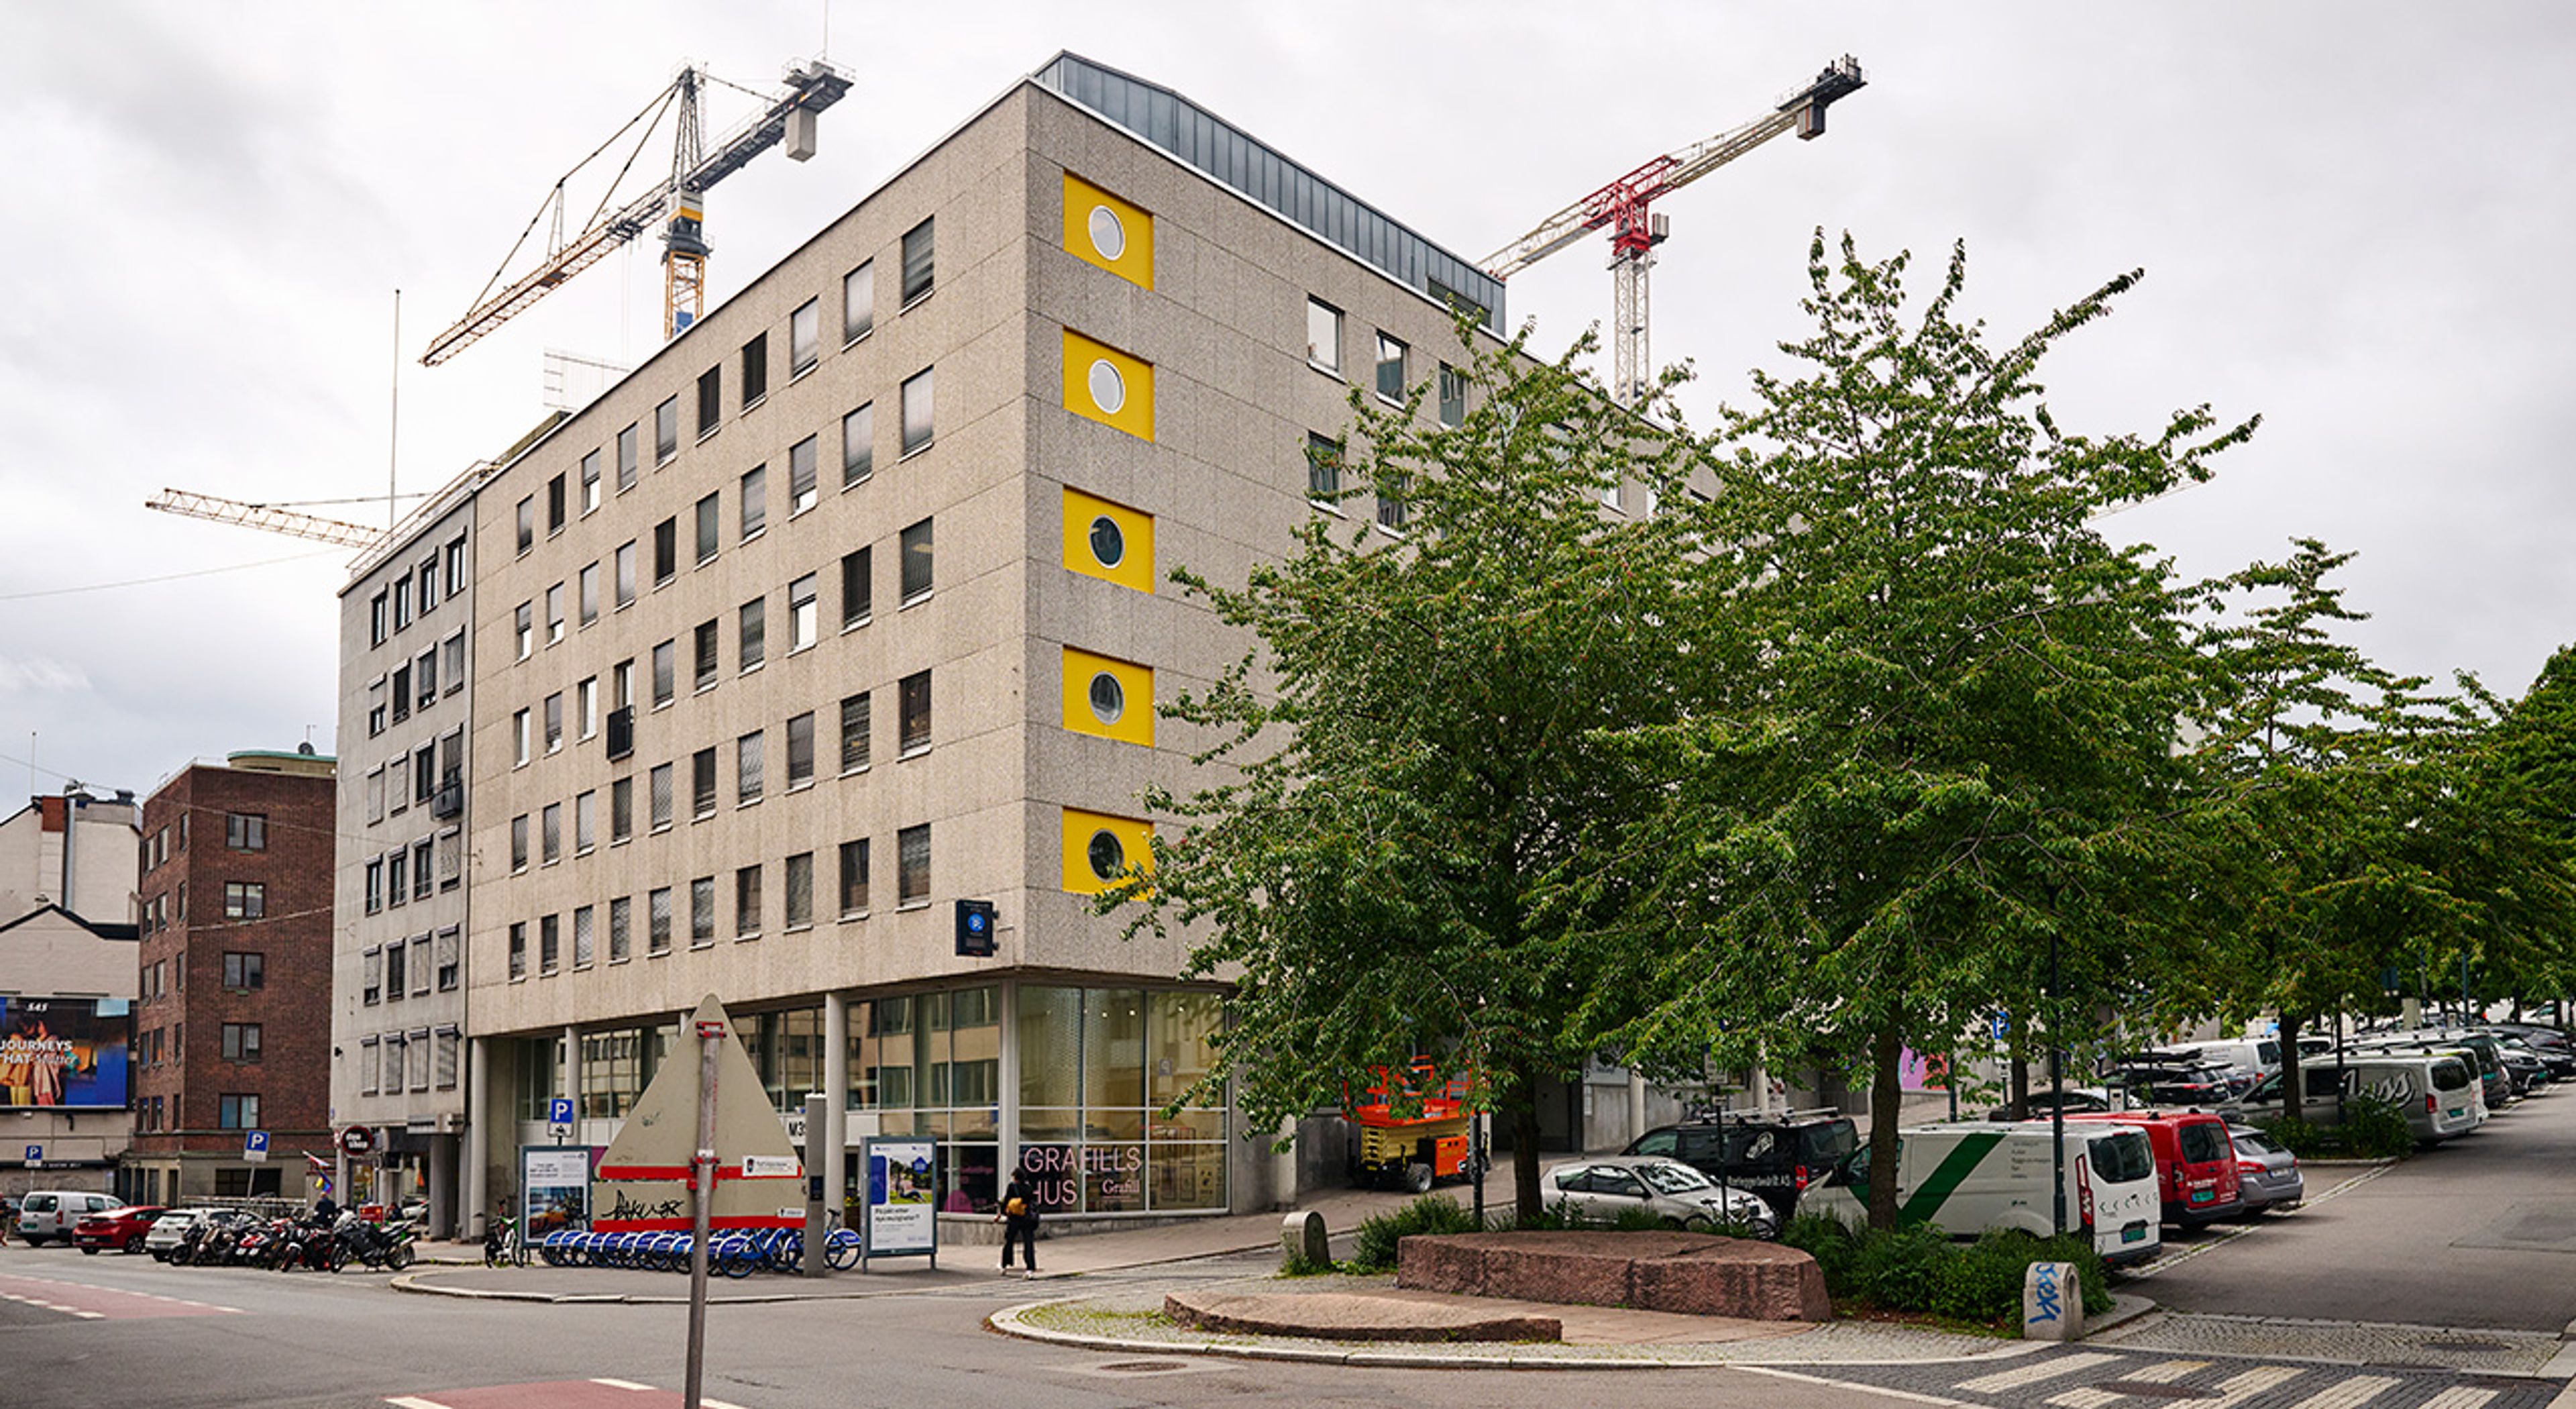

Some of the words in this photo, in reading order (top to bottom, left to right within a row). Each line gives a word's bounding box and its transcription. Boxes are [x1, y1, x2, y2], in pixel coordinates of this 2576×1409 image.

[26, 1002, 49, 1011] SAS
[0, 1041, 73, 1051] JOURNEYS
[555, 1102, 568, 1120] P
[251, 1134, 265, 1148] P
[30, 1147, 39, 1158] P
[1024, 1146, 1141, 1173] GRAFILLS
[1102, 1179, 1140, 1194] Grafill
